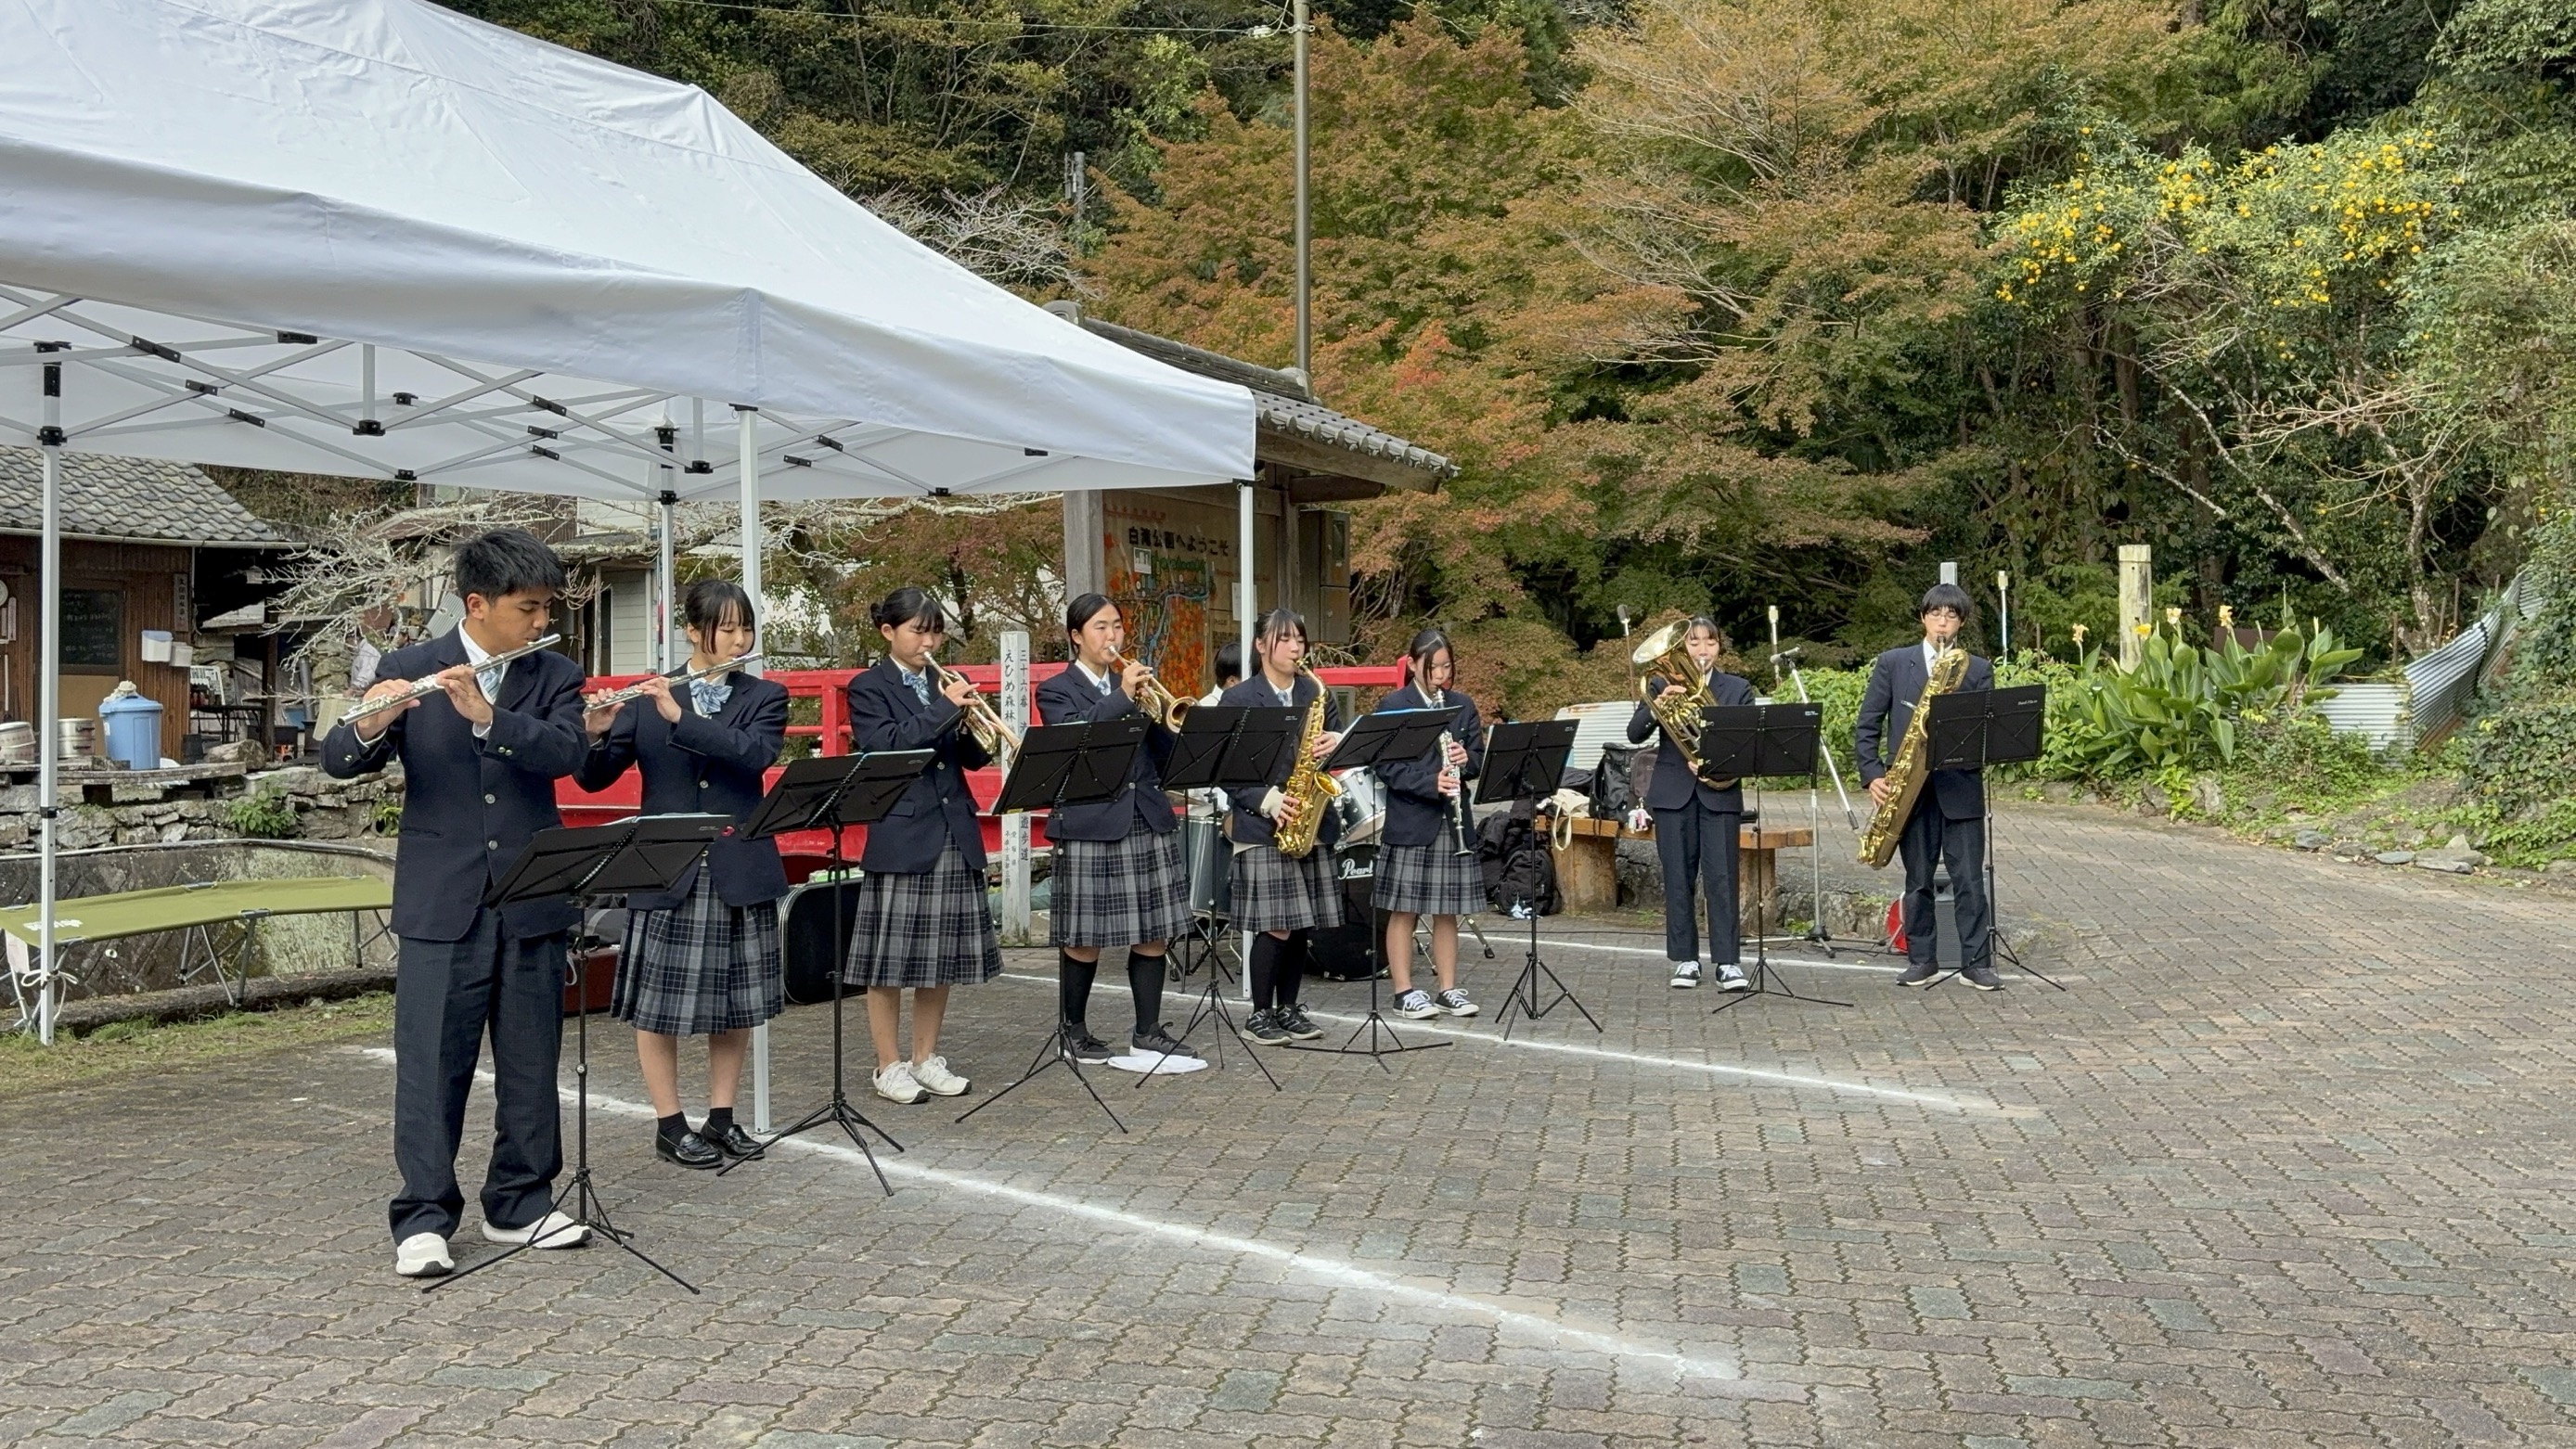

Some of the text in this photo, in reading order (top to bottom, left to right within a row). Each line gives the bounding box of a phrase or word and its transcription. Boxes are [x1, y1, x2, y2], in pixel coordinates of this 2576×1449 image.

[1004, 649, 1016, 734] えひめ森林
[1019, 649, 1028, 708] 三十六番
[1020, 815, 1029, 861] 遊歩道
[1337, 858, 1373, 880] Pearl
